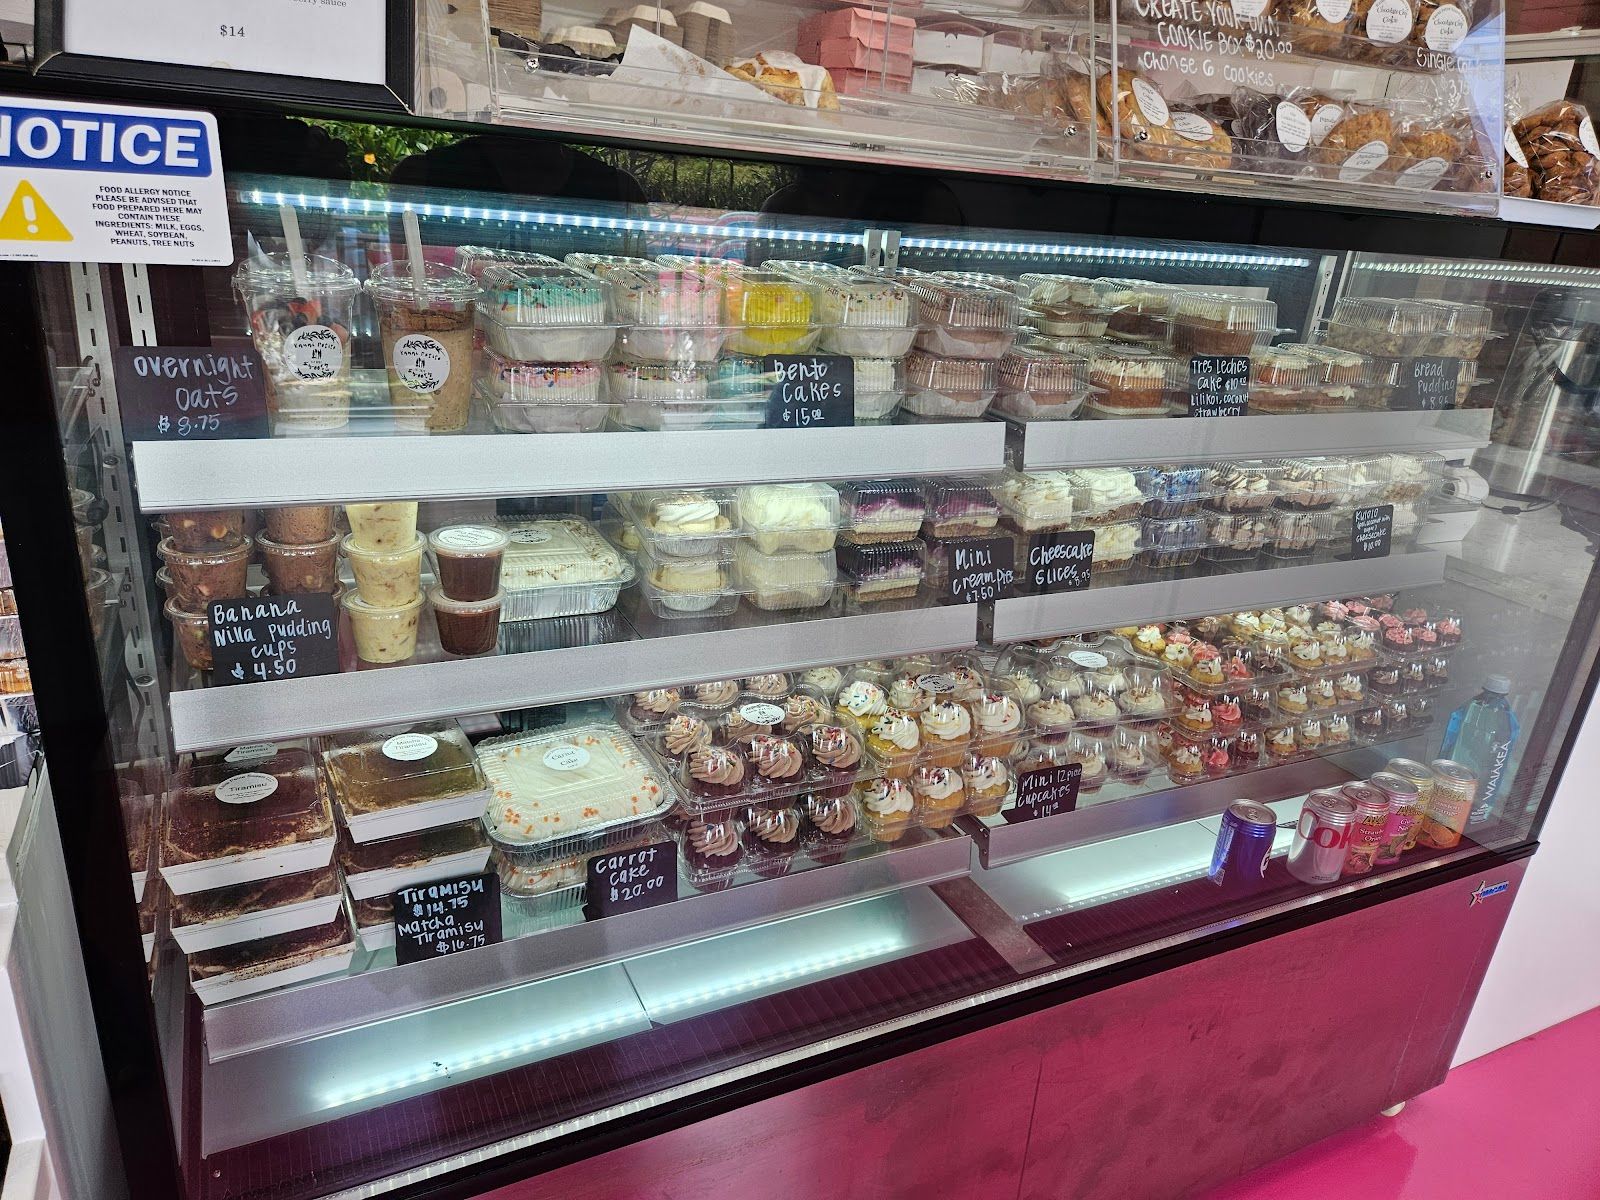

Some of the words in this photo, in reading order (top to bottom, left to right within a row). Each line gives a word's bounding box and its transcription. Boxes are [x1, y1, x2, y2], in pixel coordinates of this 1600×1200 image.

[220, 24, 246, 38] $14
[125, 187, 160, 195] ALLERGY
[162, 189, 191, 197] NOTICE
[96, 194, 127, 203] PLEASE
[142, 197, 176, 205] ADVISED
[178, 198, 197, 206] THAT
[92, 203, 115, 211] FOOD
[117, 204, 160, 212] PREPARED
[162, 206, 183, 214] HERE
[186, 207, 202, 215] MAY
[118, 213, 154, 221] CONTAIN
[155, 214, 181, 222] THESE
[95, 220, 153, 230] INGREDIENTS:
[173, 240, 195, 248] NUTS
[774, 358, 828, 382] Bento
[1192, 360, 1213, 374] Tres
[1216, 358, 1248, 375] Leches
[955, 545, 992, 571] Mini
[214, 600, 301, 625] Banana
